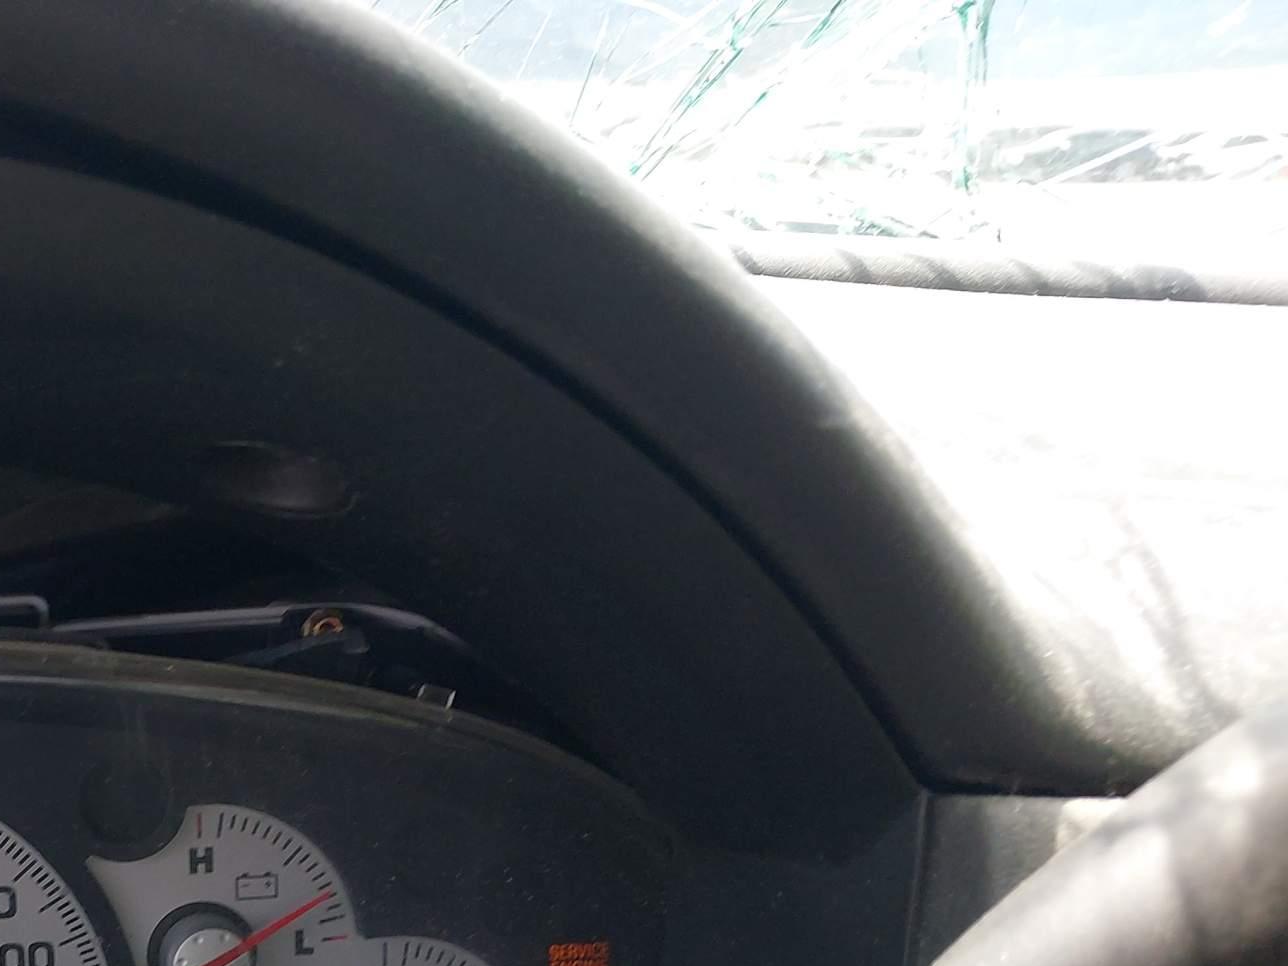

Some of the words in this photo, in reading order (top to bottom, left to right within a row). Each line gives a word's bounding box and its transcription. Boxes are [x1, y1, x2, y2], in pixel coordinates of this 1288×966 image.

[189, 847, 213, 874] H
[295, 930, 314, 956] L
[549, 942, 609, 960] SERVICE
